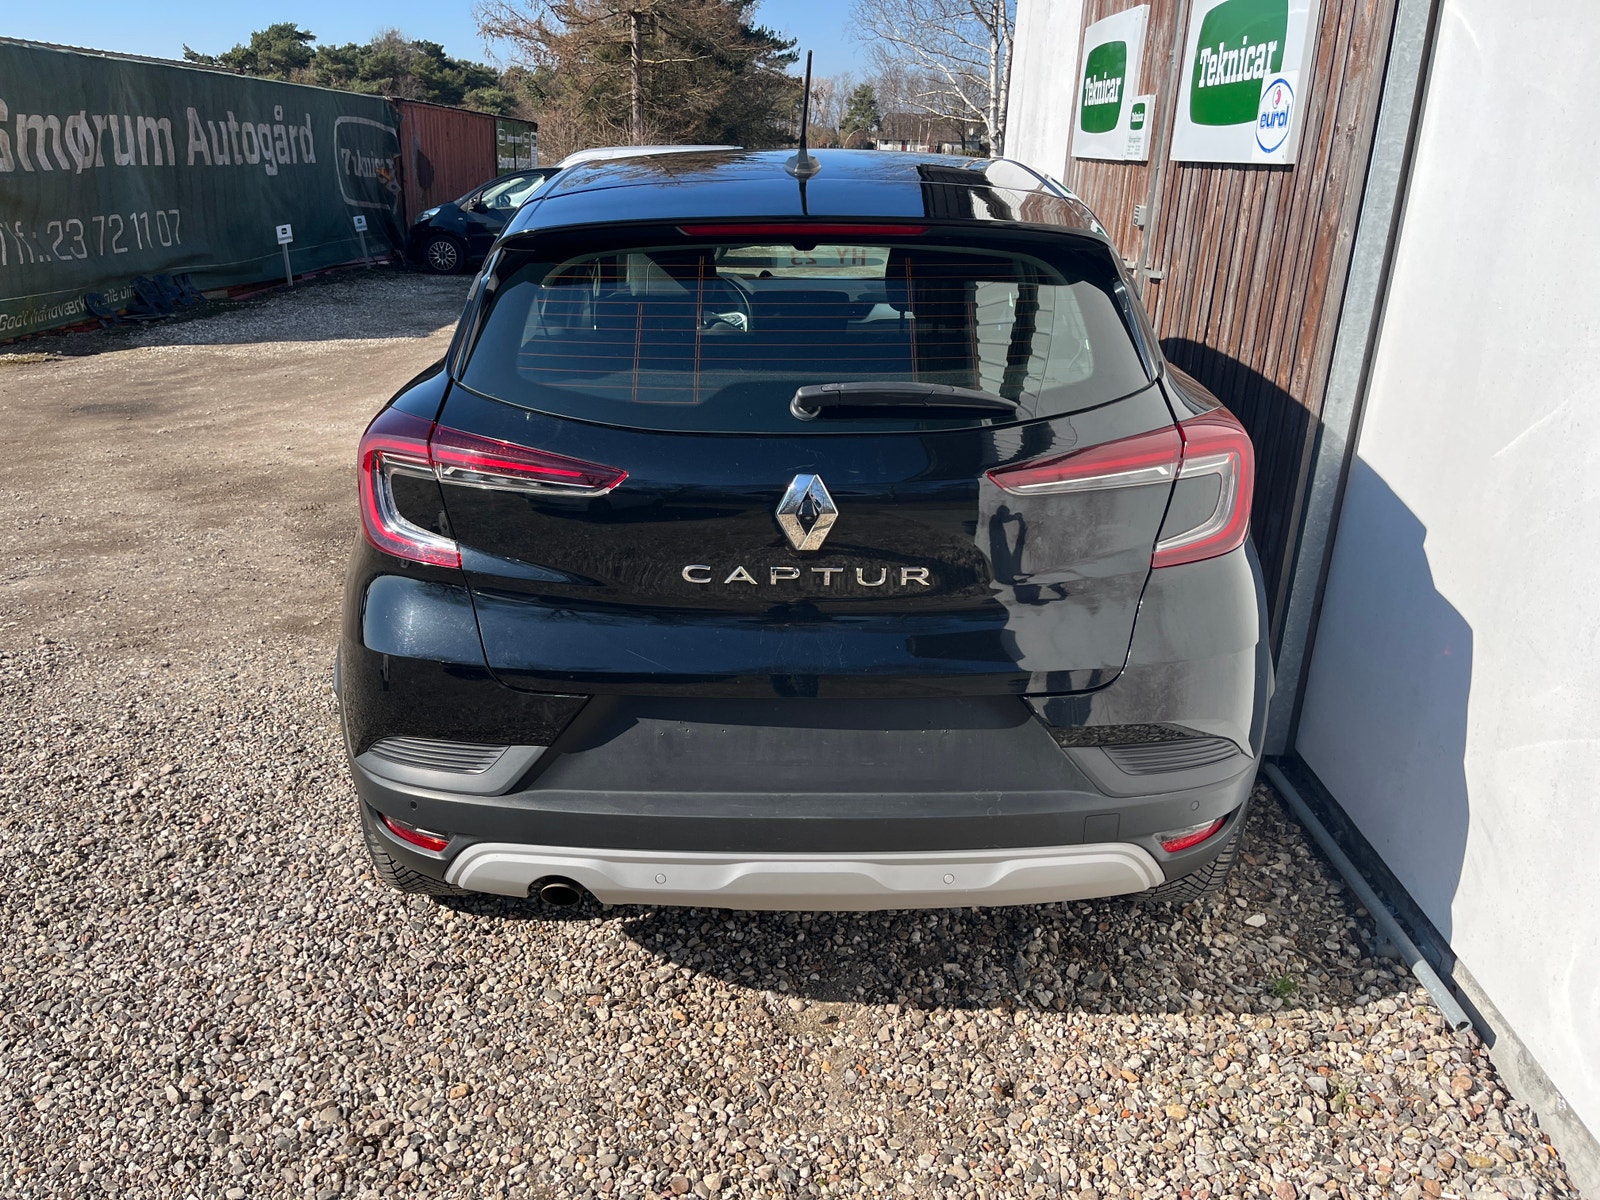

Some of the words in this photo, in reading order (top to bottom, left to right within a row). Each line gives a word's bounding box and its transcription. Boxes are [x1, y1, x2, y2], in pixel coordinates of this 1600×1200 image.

[1198, 36, 1277, 88] Teknicar
[1084, 72, 1121, 106] Teknicar
[1260, 104, 1290, 128] eurol
[186, 105, 316, 176] Autogård
[47, 219, 87, 260] 23
[92, 214, 128, 256] 72
[130, 211, 153, 250] 11
[156, 209, 181, 247] 07
[681, 564, 931, 587] CAPTUR
